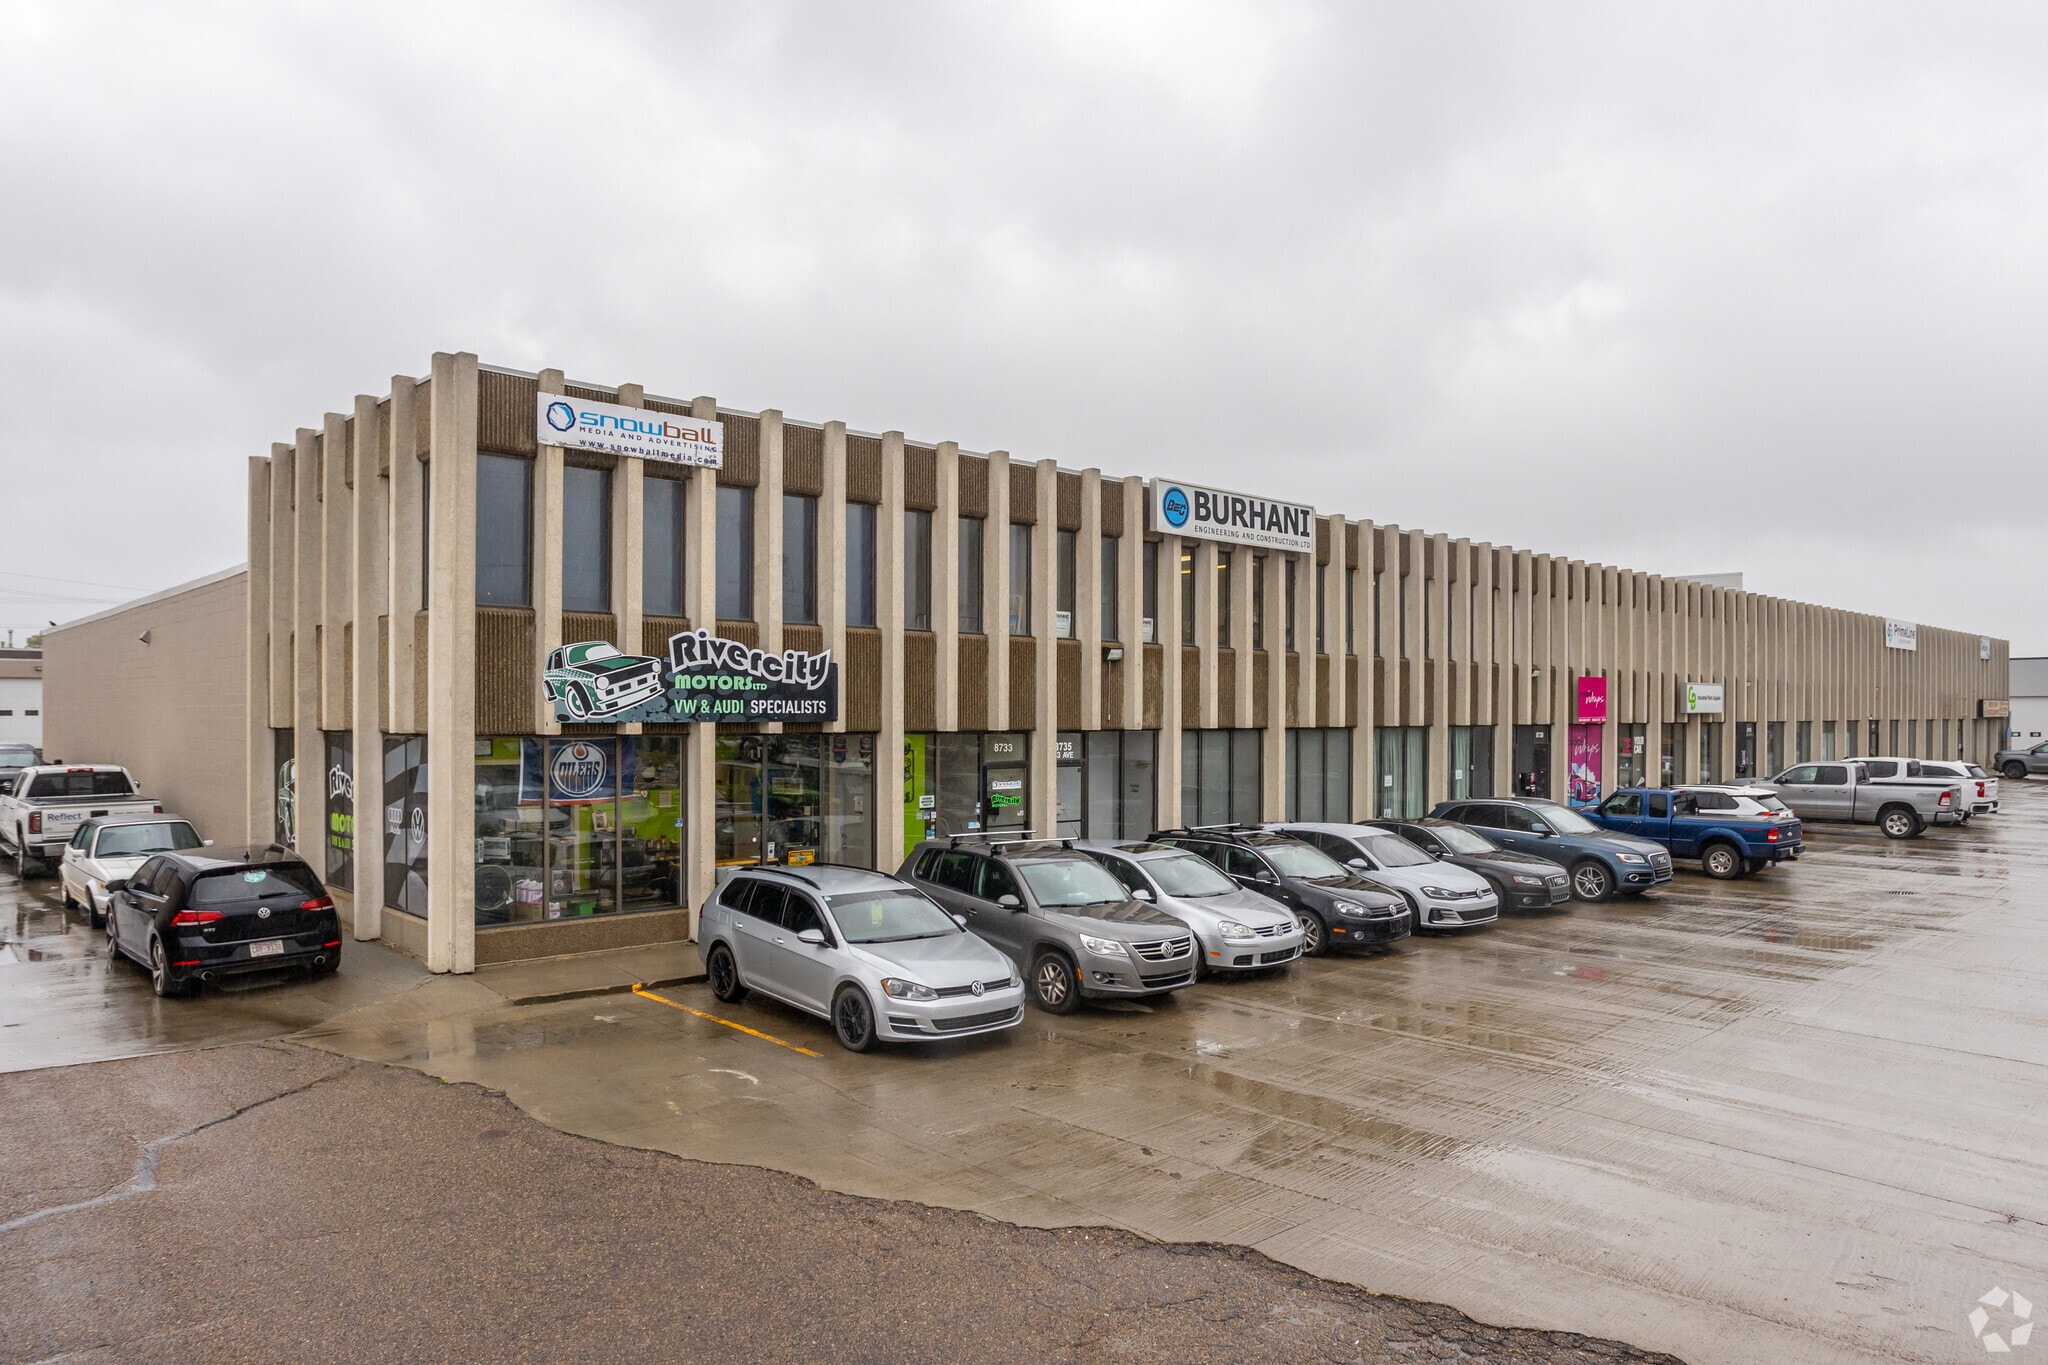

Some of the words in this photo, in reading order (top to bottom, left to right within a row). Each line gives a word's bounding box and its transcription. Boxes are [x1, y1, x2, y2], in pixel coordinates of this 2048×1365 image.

[580, 411, 717, 445] snowball
[579, 426, 614, 437] MEDIA
[620, 432, 642, 442] AND
[648, 437, 718, 453] ADVERTISING
[579, 438, 718, 466] www.snowballmedia.com
[1194, 490, 1310, 538] BURHANI
[1194, 525, 1240, 539] ENGINEERING
[1242, 532, 1255, 541] AND
[1256, 534, 1299, 547] CONSTRUCTION
[1300, 541, 1311, 549] LTD
[669, 628, 831, 690] Rivercity
[674, 675, 752, 690] MOTORS
[752, 683, 767, 691] LTD
[674, 700, 698, 714] VW
[700, 700, 710, 714] &
[713, 700, 744, 714] AUDI
[750, 700, 827, 714] SPECIALISTS
[993, 743, 1013, 753] 8733
[1062, 751, 1074, 759] AVE
[558, 760, 601, 777] OILERS
[47, 812, 82, 821] Reflect
